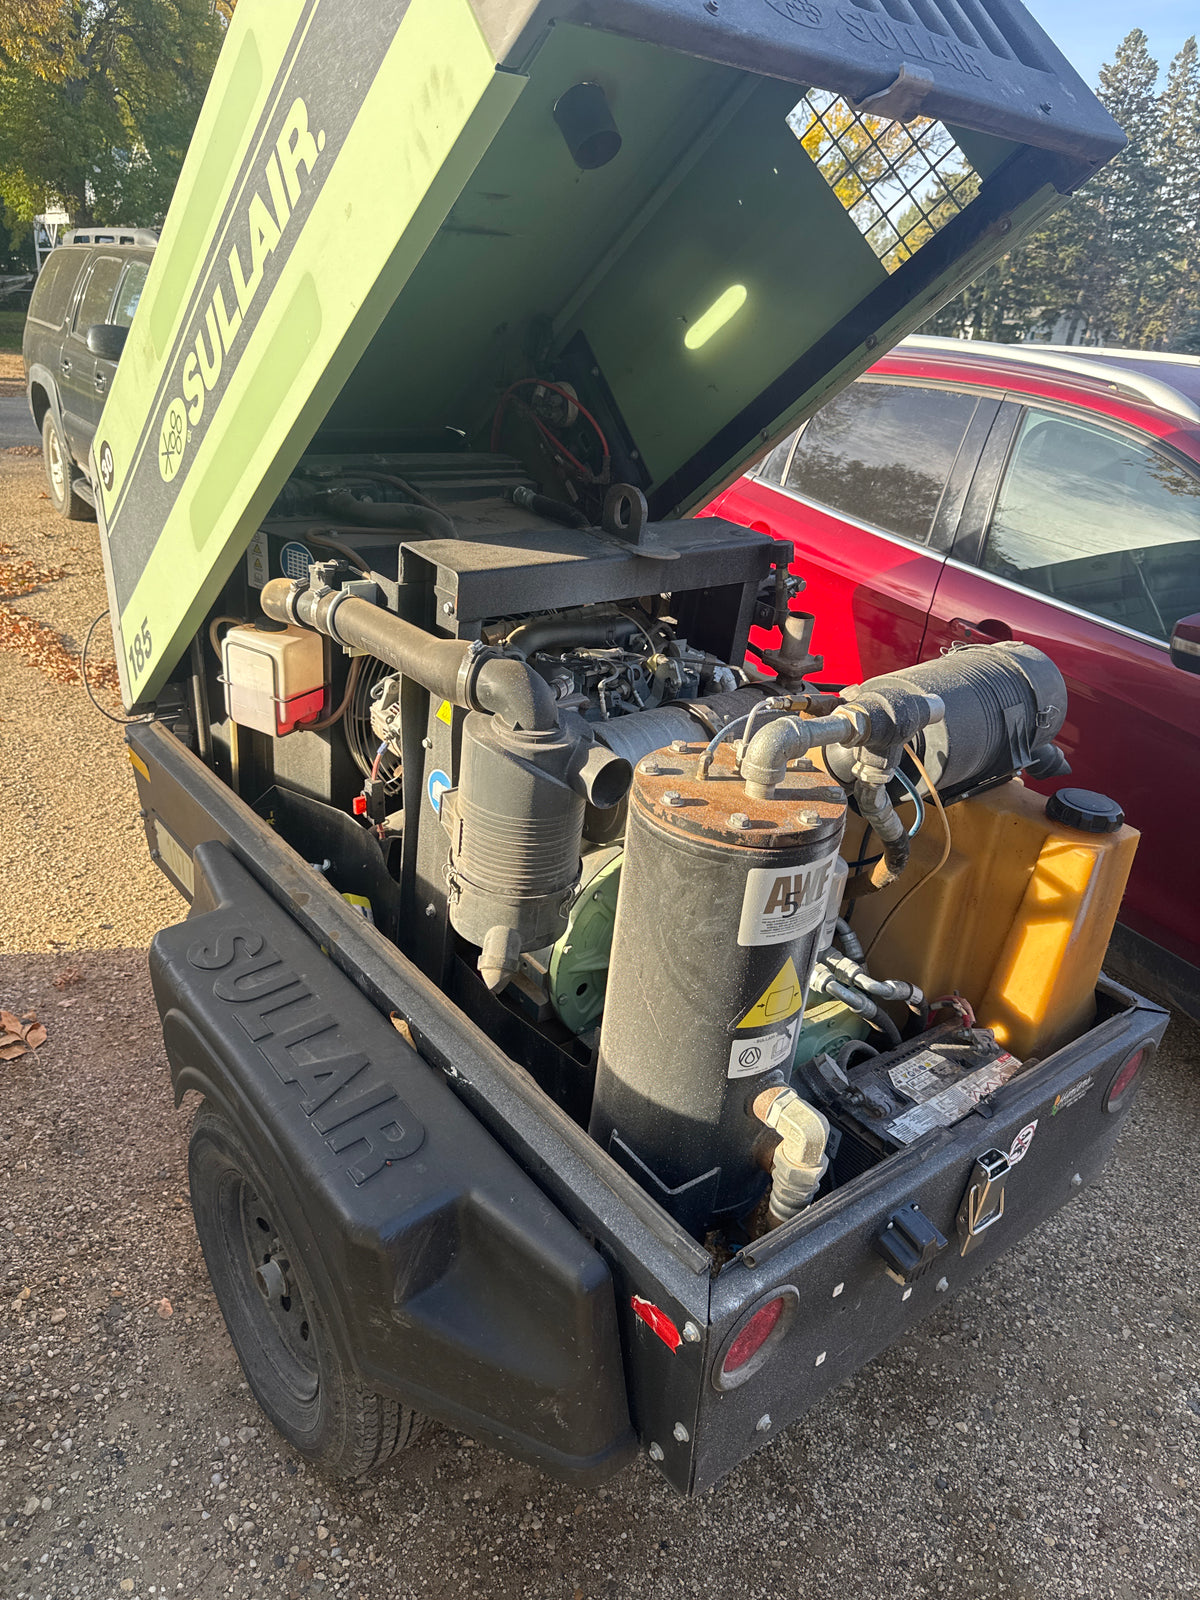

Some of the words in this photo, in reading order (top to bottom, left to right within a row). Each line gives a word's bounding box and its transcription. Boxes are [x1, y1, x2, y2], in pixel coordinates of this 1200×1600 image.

[835, 8, 993, 82] SULLAIR
[101, 447, 113, 485] 30
[128, 615, 153, 682] 185
[763, 858, 833, 915] AWF
[186, 925, 428, 1188] SULLAIR
